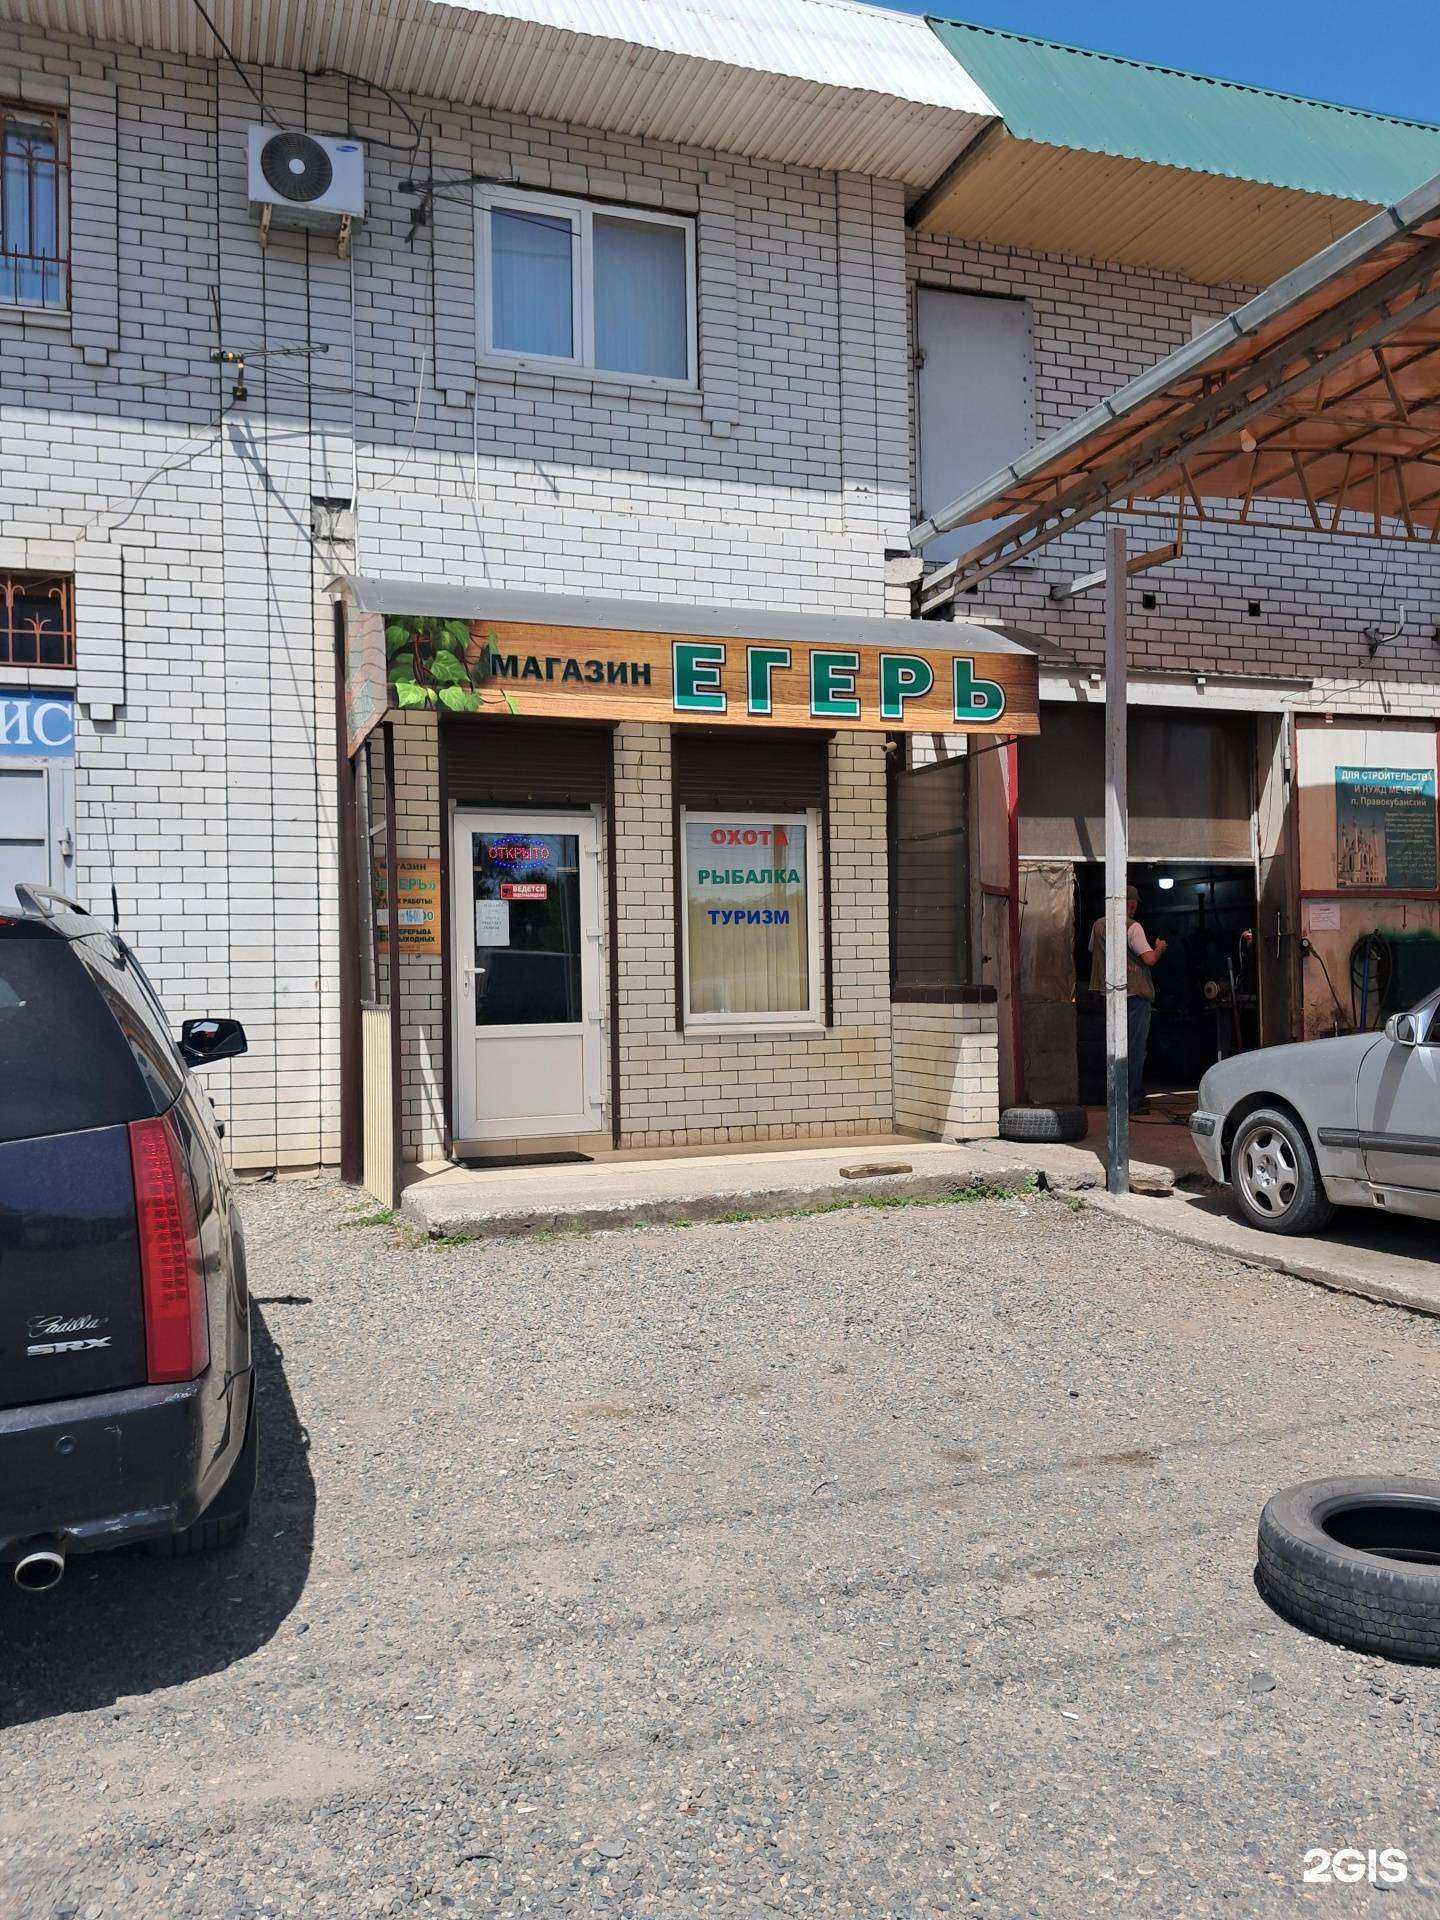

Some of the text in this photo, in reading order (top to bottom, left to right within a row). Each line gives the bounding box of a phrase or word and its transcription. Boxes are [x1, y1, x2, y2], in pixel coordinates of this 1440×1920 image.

[491, 640, 1007, 725] МАГАЗИН ЕГЕРЬ
[1342, 770, 1433, 782] ДЛЯ СТРОИТЕЛЬСТВА
[1362, 785, 1387, 794] НУЖД
[711, 829, 789, 848] ОХОТА
[488, 847, 550, 859] ОТКРЫТО
[698, 869, 800, 885] РЫБАЛКА
[707, 909, 790, 925] ТУРИЗМ
[27, 1314, 109, 1339] Cadillac
[27, 1336, 112, 1356] SRX
